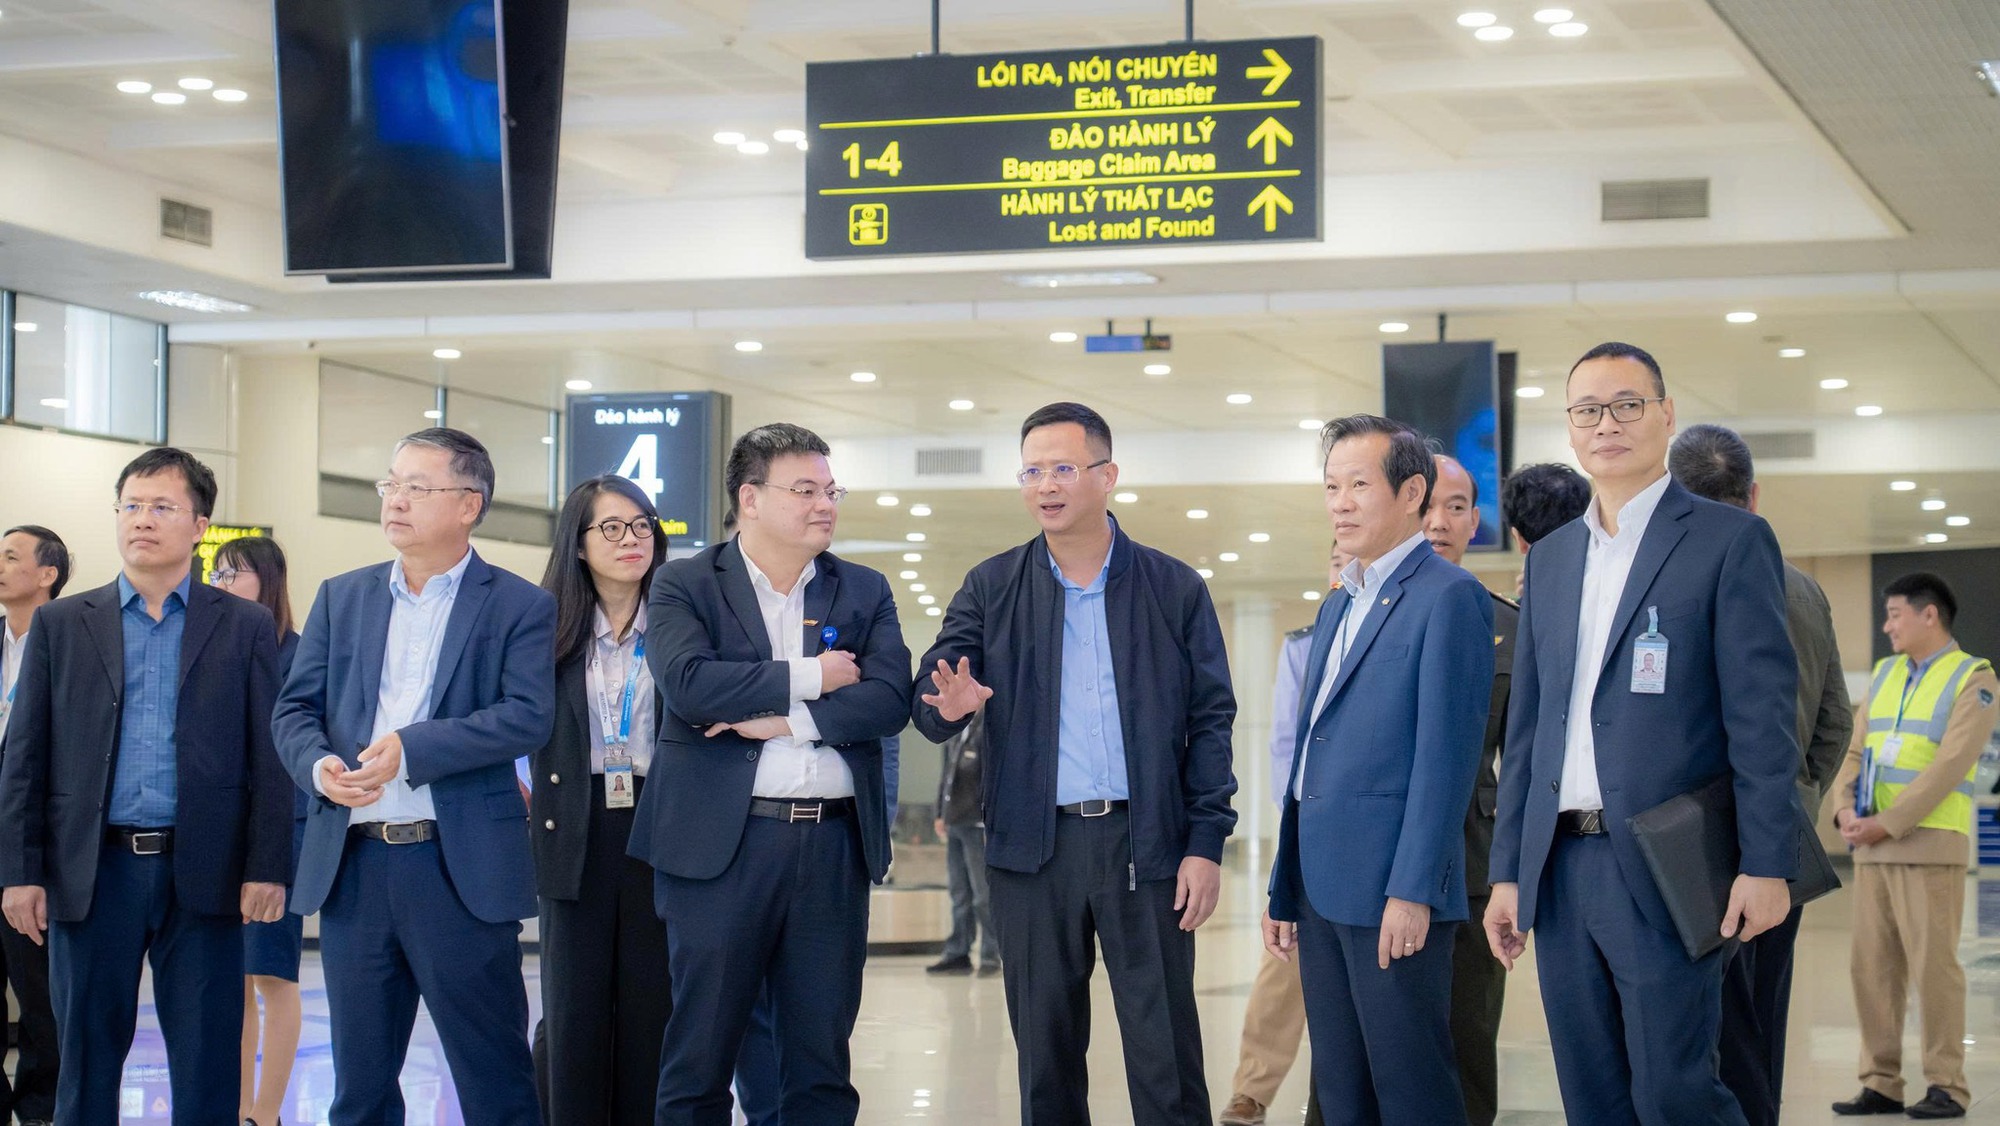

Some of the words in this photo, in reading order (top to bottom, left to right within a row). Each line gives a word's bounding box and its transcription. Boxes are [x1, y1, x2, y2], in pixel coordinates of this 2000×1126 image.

[1021, 62, 1064, 87] RA,
[1074, 86, 1122, 110] Exit,
[1124, 80, 1217, 107] Transfer
[1108, 118, 1179, 148] HÀNH
[1182, 115, 1217, 145] LÝ
[842, 140, 903, 179] 1-4
[1002, 157, 1096, 181] Baggage
[1098, 152, 1162, 177] Claim
[1163, 150, 1217, 174] Area
[1000, 188, 1066, 216] HÀNH
[1068, 185, 1100, 214] LÝ
[1165, 185, 1214, 213] LẠC
[1048, 220, 1098, 243] Lost
[1099, 217, 1142, 241] and
[1145, 214, 1215, 239] Found
[665, 407, 681, 427] lý
[615, 433, 664, 509] 4
[659, 519, 688, 536] aim
